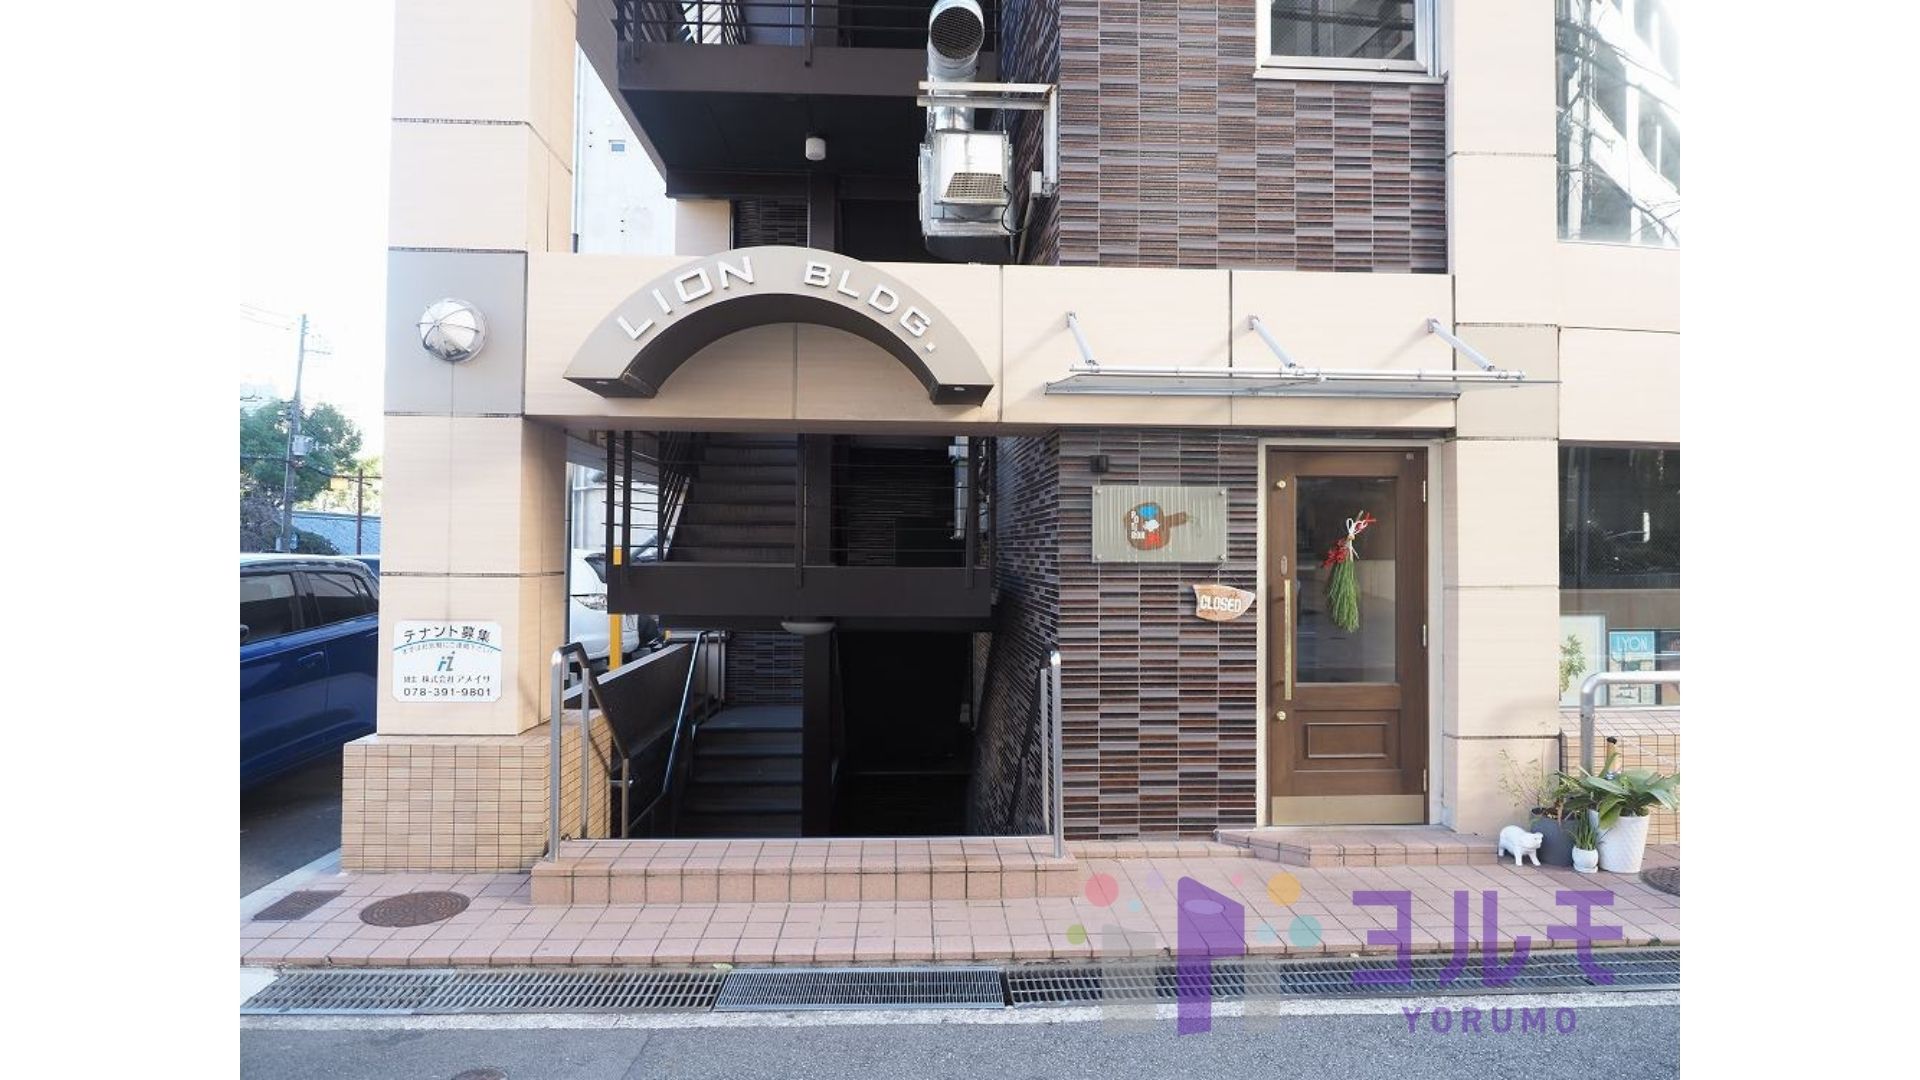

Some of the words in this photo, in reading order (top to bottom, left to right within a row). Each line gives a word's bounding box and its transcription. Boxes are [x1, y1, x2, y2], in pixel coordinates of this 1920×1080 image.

[617, 256, 756, 341] LION
[804, 261, 937, 353] BLDG.
[1200, 595, 1242, 613] CLOSED
[404, 625, 490, 643] テナント募集
[1616, 635, 1648, 651] LYON
[403, 687, 491, 696] 078-391-9801
